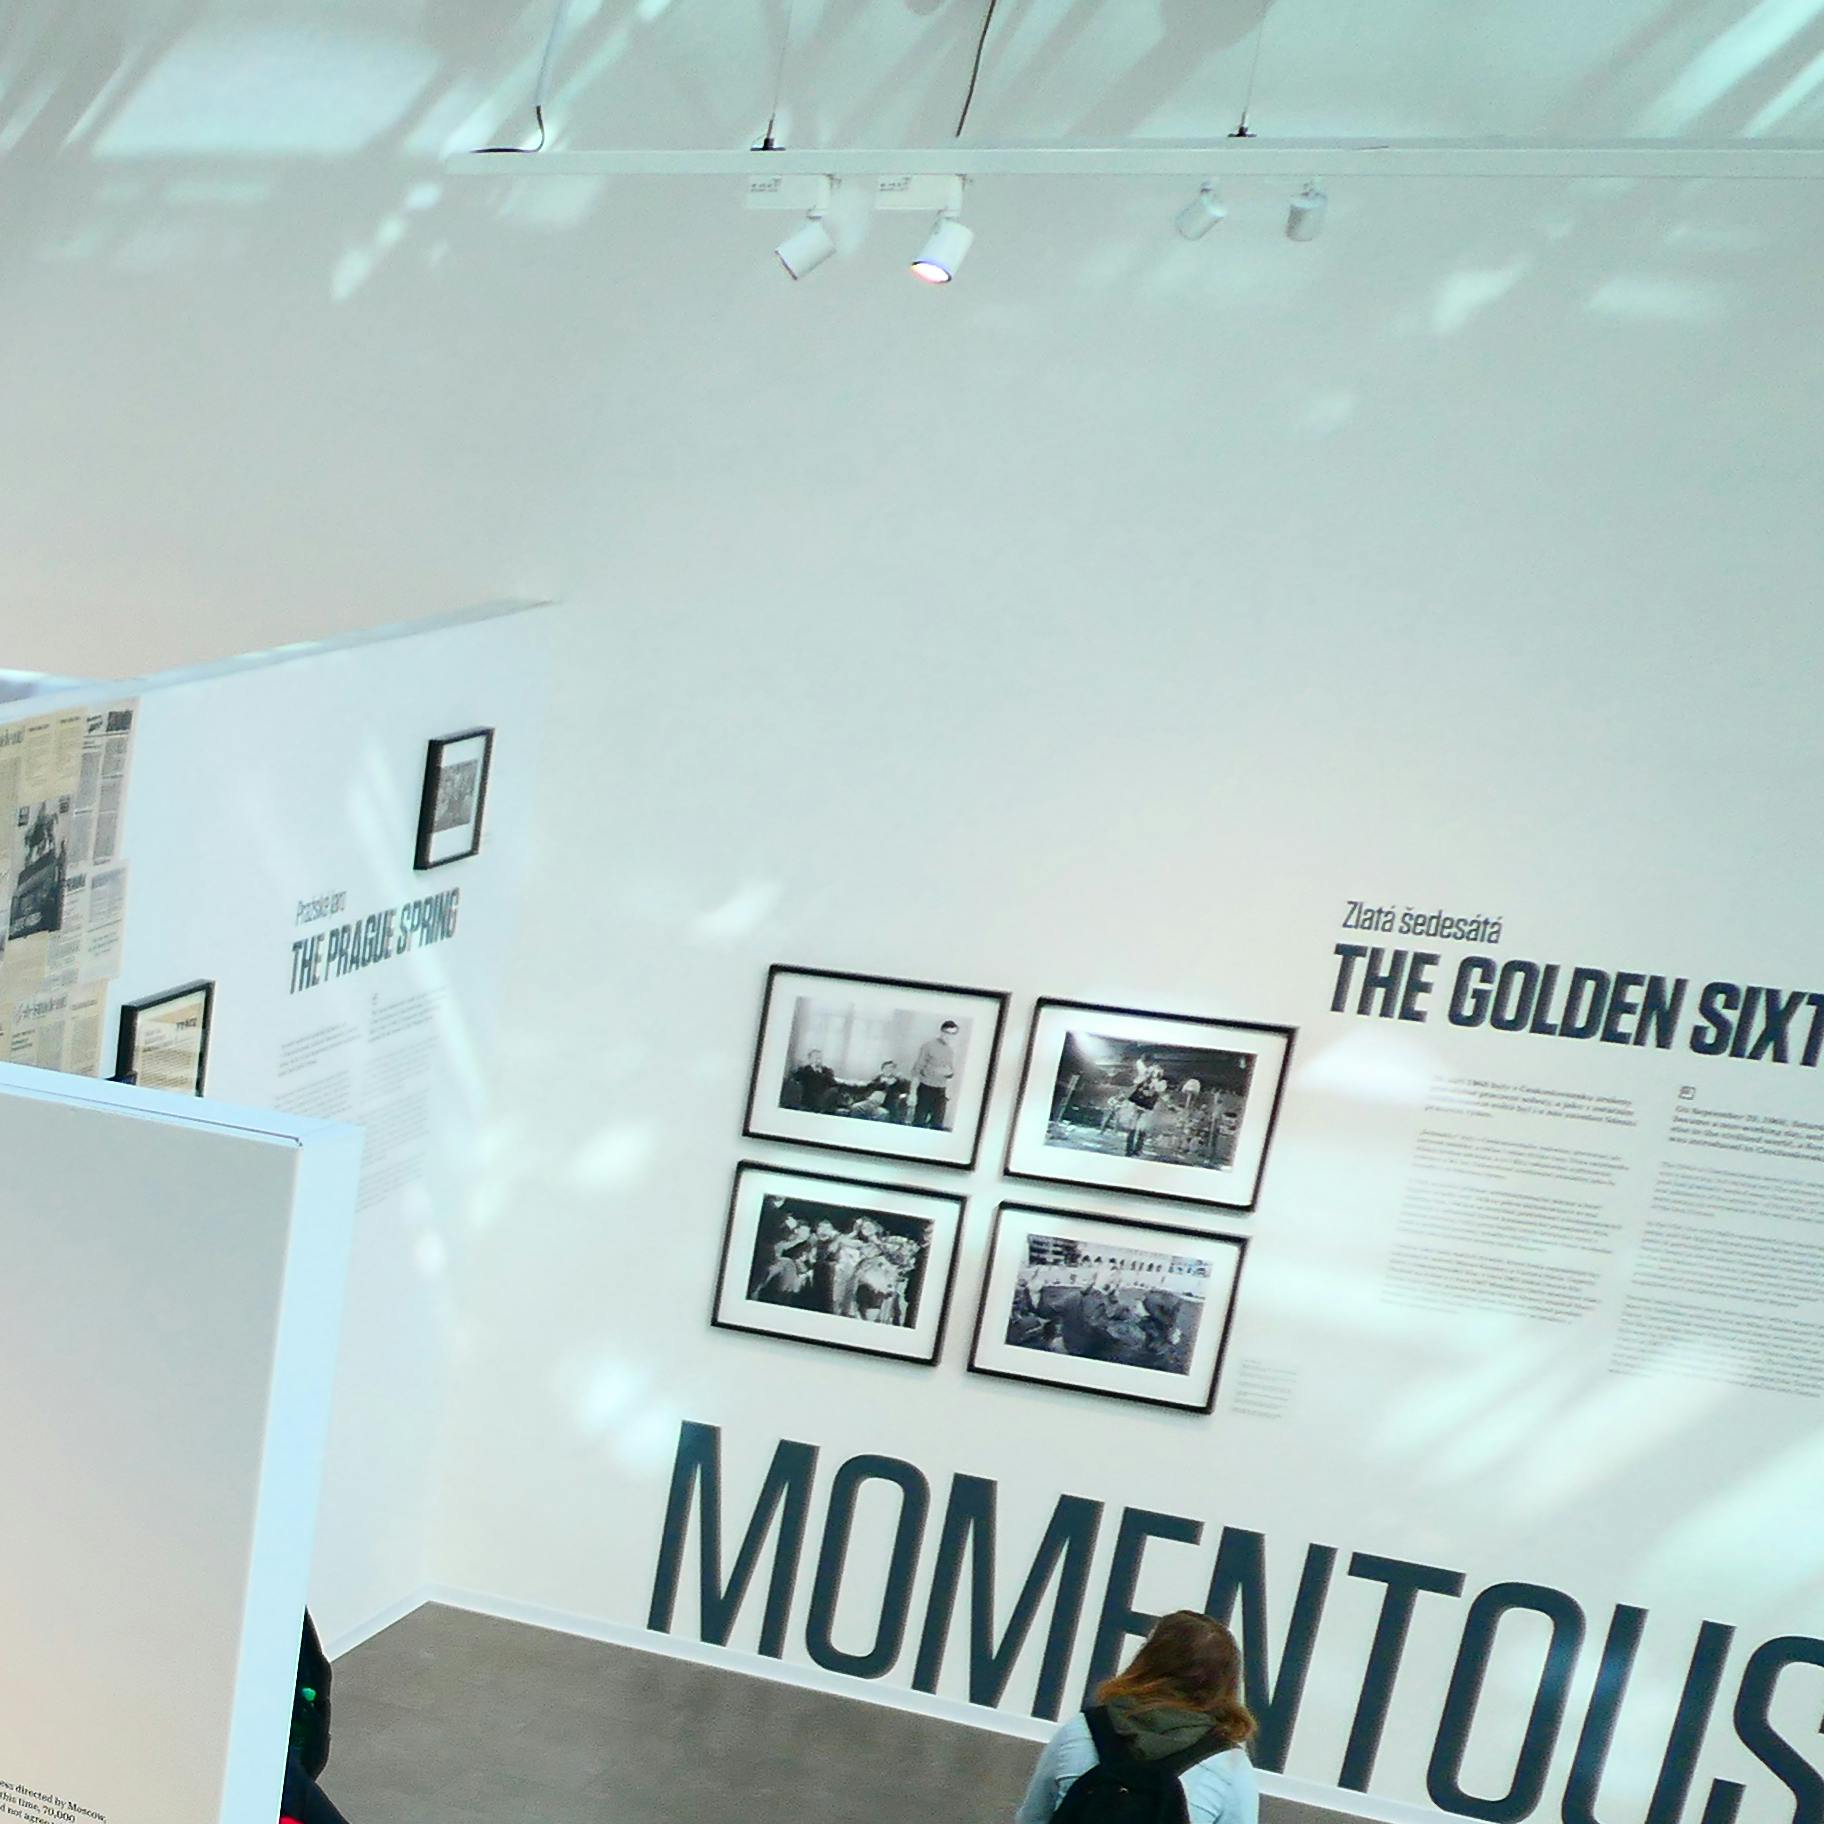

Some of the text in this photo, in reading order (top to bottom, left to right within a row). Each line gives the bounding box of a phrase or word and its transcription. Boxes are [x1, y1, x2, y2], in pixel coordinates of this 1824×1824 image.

[290, 887, 460, 994] THE PRAGUE SPRING
[1342, 900, 1503, 944] Zlatá šedesátá
[1330, 943, 1824, 1068] THE GOLDEN SIXT
[0, 1790, 16, 1803] this
[18, 1796, 40, 1813] time,
[43, 1804, 75, 1823] 70,000
[7, 1807, 21, 1818] not
[15, 1783, 52, 1804] directed
[67, 1800, 106, 1824] Moscow,
